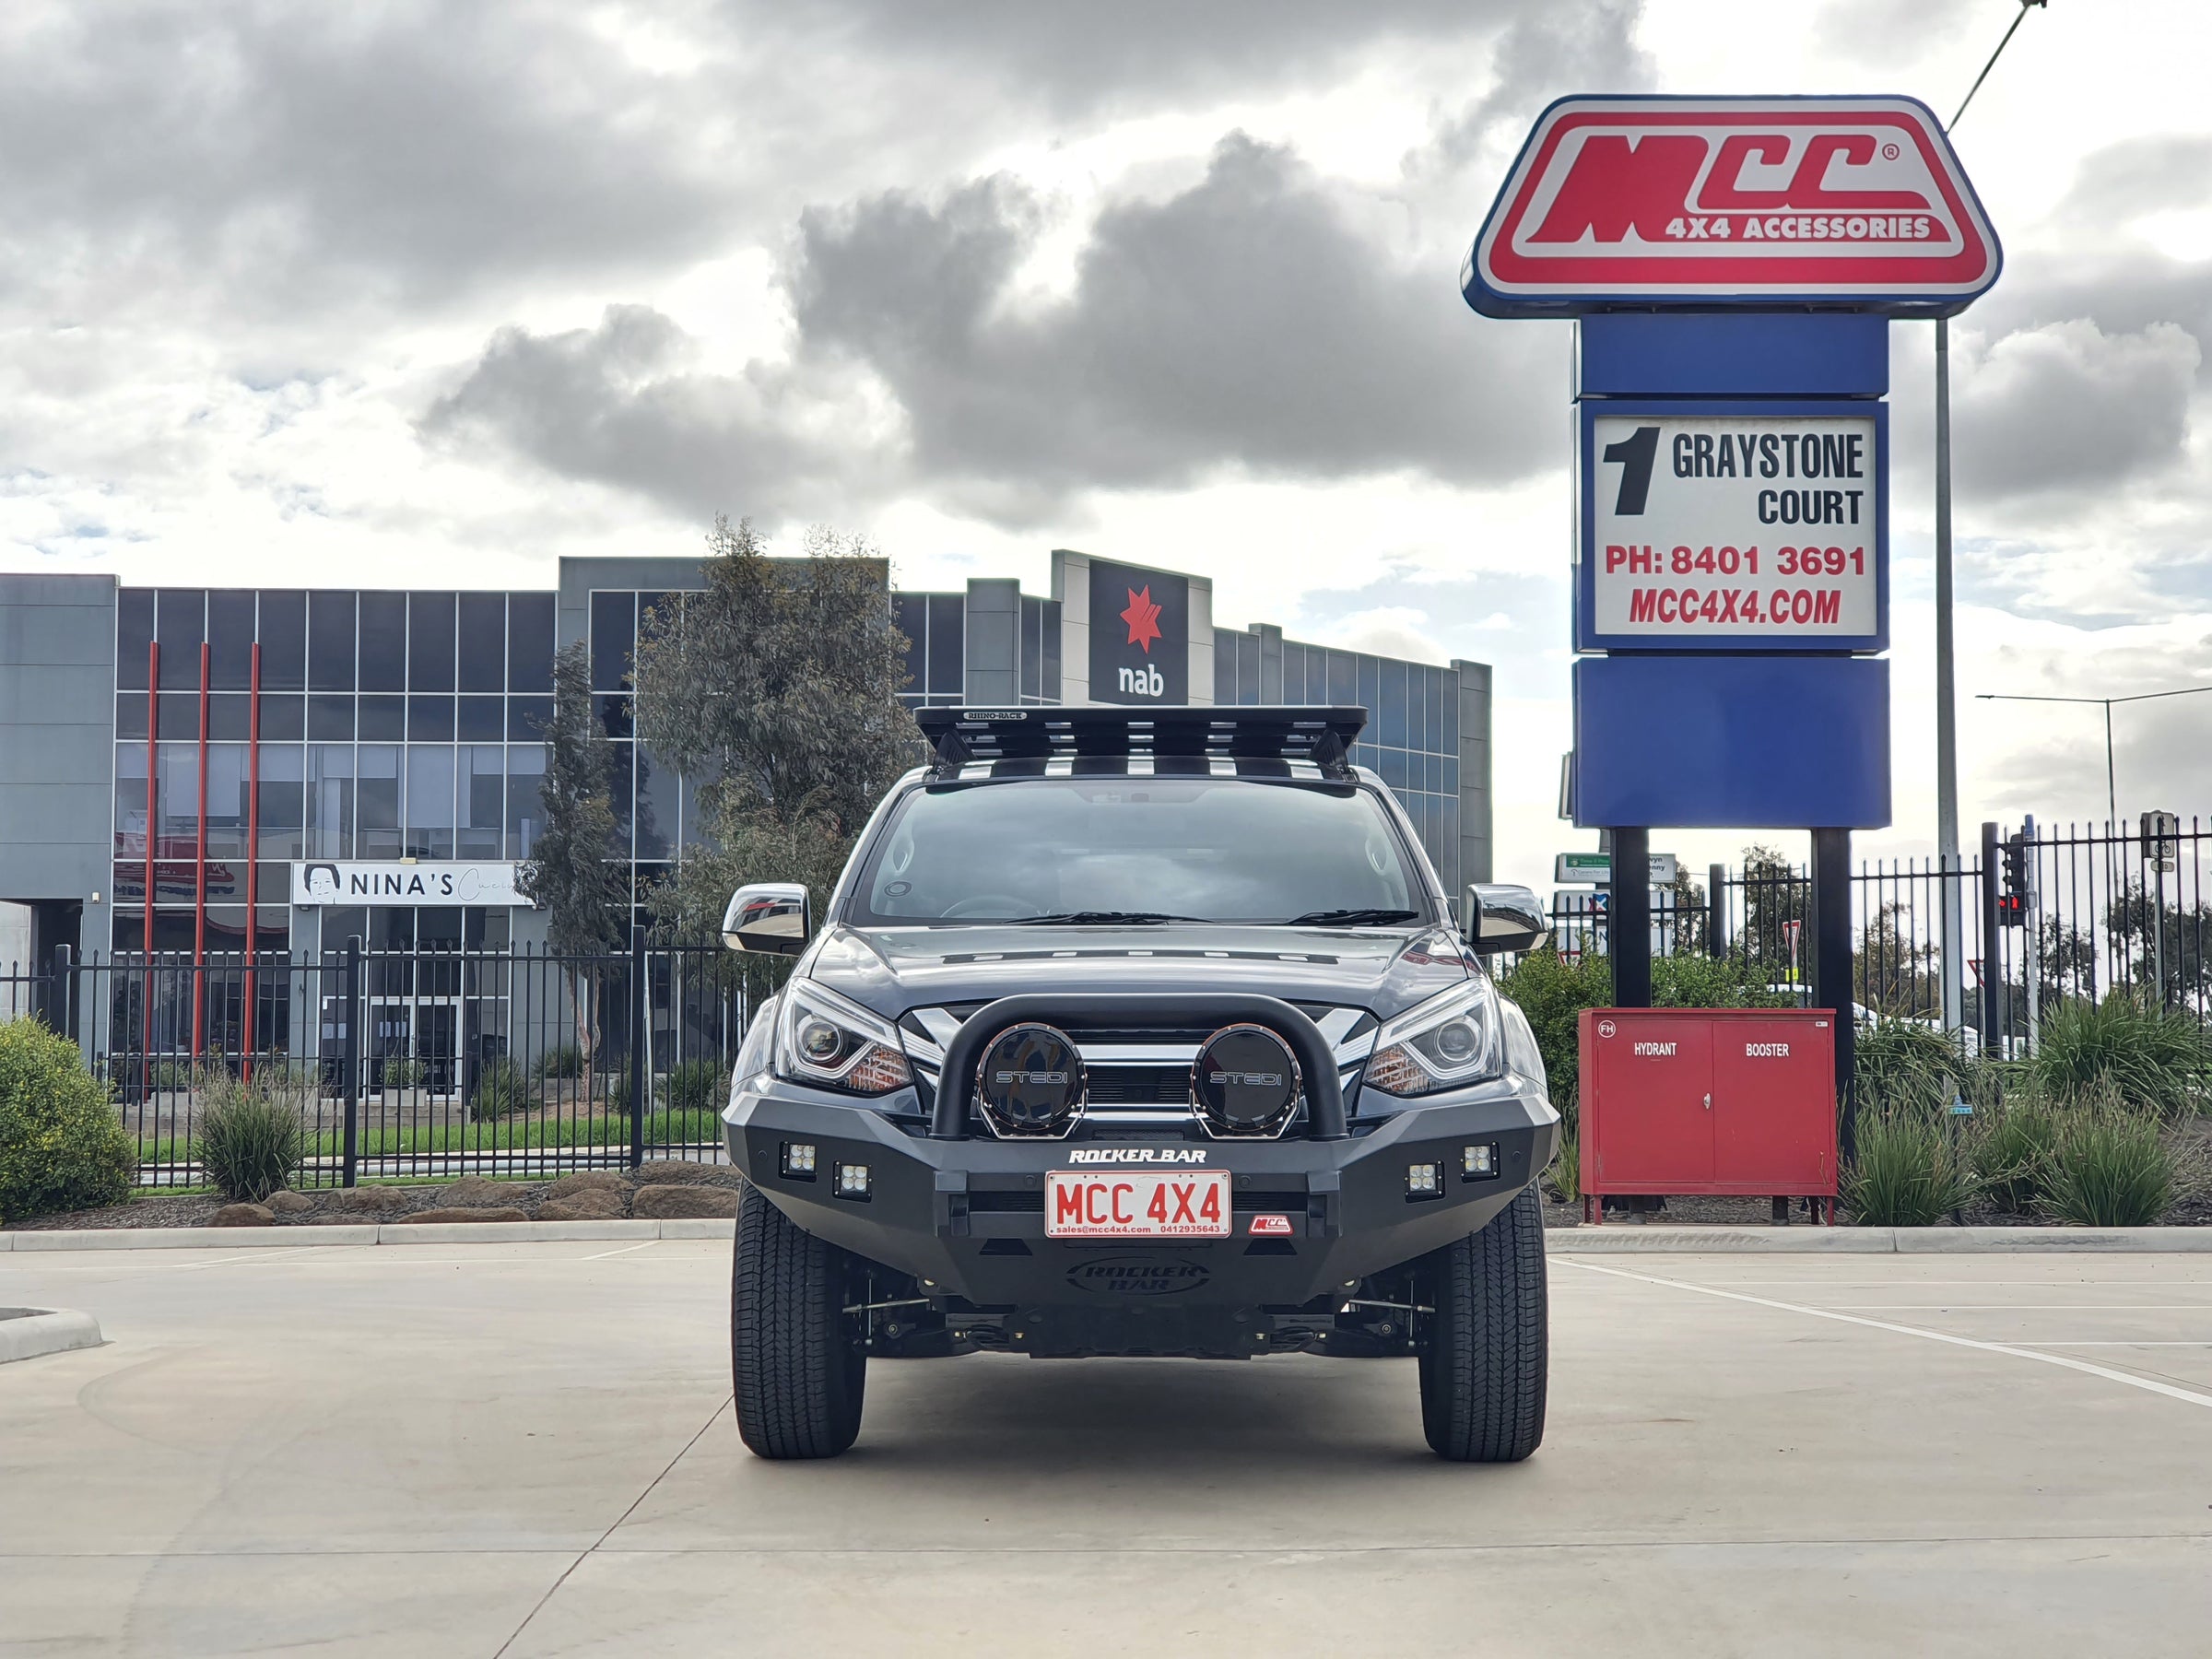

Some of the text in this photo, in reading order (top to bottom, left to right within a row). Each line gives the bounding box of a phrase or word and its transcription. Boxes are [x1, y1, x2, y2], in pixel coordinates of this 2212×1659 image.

[1525, 135, 1932, 242] MCC
[1665, 217, 1930, 239] 4X4 ACCESSORIES
[1603, 427, 1864, 515] 1 GRAYSTONE
[1758, 489, 1864, 524] COURT
[1606, 545, 1864, 575] PH: 8401 3691
[1630, 588, 1841, 624] MCC4X4.COM
[1119, 664, 1164, 697] nab
[968, 712, 1023, 720] RHINO-RACK
[351, 873, 453, 895] NINA'S
[1600, 1025, 1614, 1033] FH
[1634, 1042, 1677, 1055] HYDRANT
[1747, 1043, 1789, 1057] BOOSTER
[995, 1071, 1068, 1084] STEDI
[1209, 1071, 1282, 1086] STEDI
[1068, 1149, 1206, 1164] ROCKER BAR
[1056, 1182, 1221, 1224] MCC 4X4
[1056, 1225, 1220, 1234] sales@mcc4x4.com 0412935643
[1253, 1218, 1287, 1230] MCC
[1085, 1265, 1197, 1278] ROCKER
[1108, 1278, 1170, 1290] BAR
